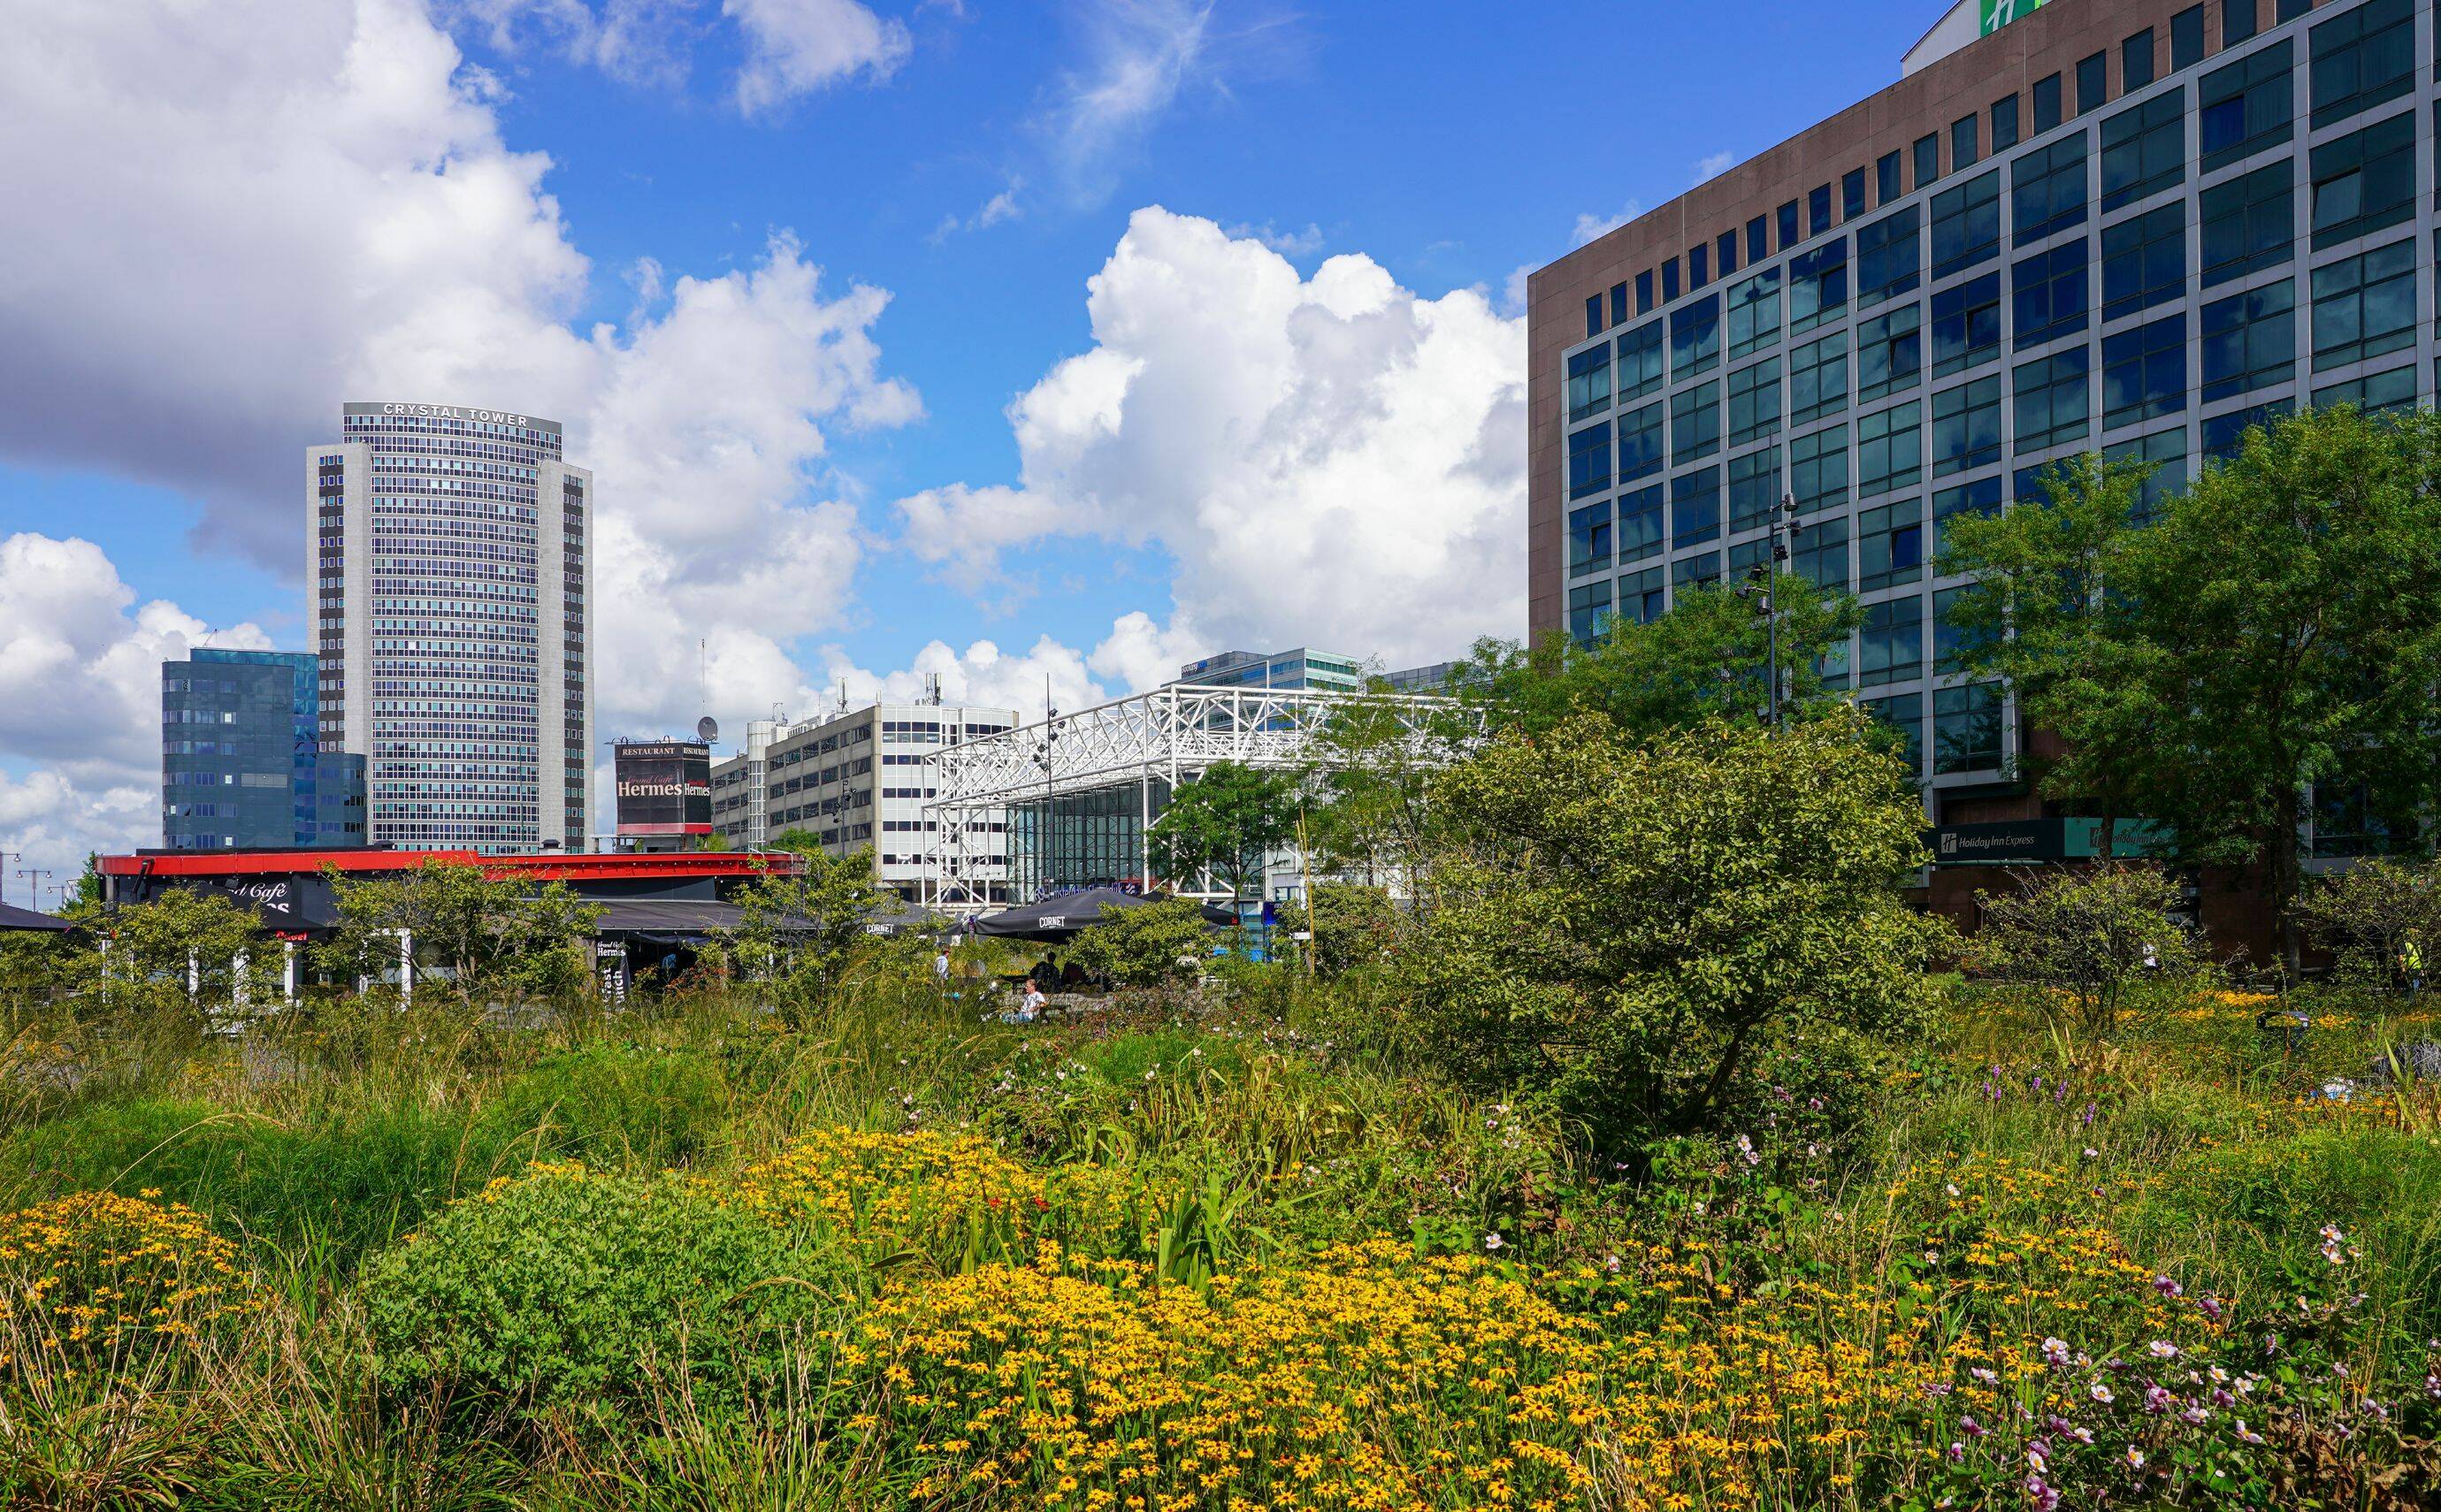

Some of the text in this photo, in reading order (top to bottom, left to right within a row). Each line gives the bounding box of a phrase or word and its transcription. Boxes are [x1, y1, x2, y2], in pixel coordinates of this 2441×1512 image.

[383, 403, 527, 427] CRYSTAL TOWER
[622, 747, 676, 756] RESTAURANT
[683, 747, 709, 756] RESTAURANT
[618, 781, 683, 797] Hermes
[684, 783, 710, 797] Hermes
[1959, 836, 1991, 849] Holiday
[1991, 836, 2004, 846] Inn
[2005, 836, 2035, 847] Express
[1038, 916, 1066, 928] CORNET
[867, 923, 894, 934] CORNET
